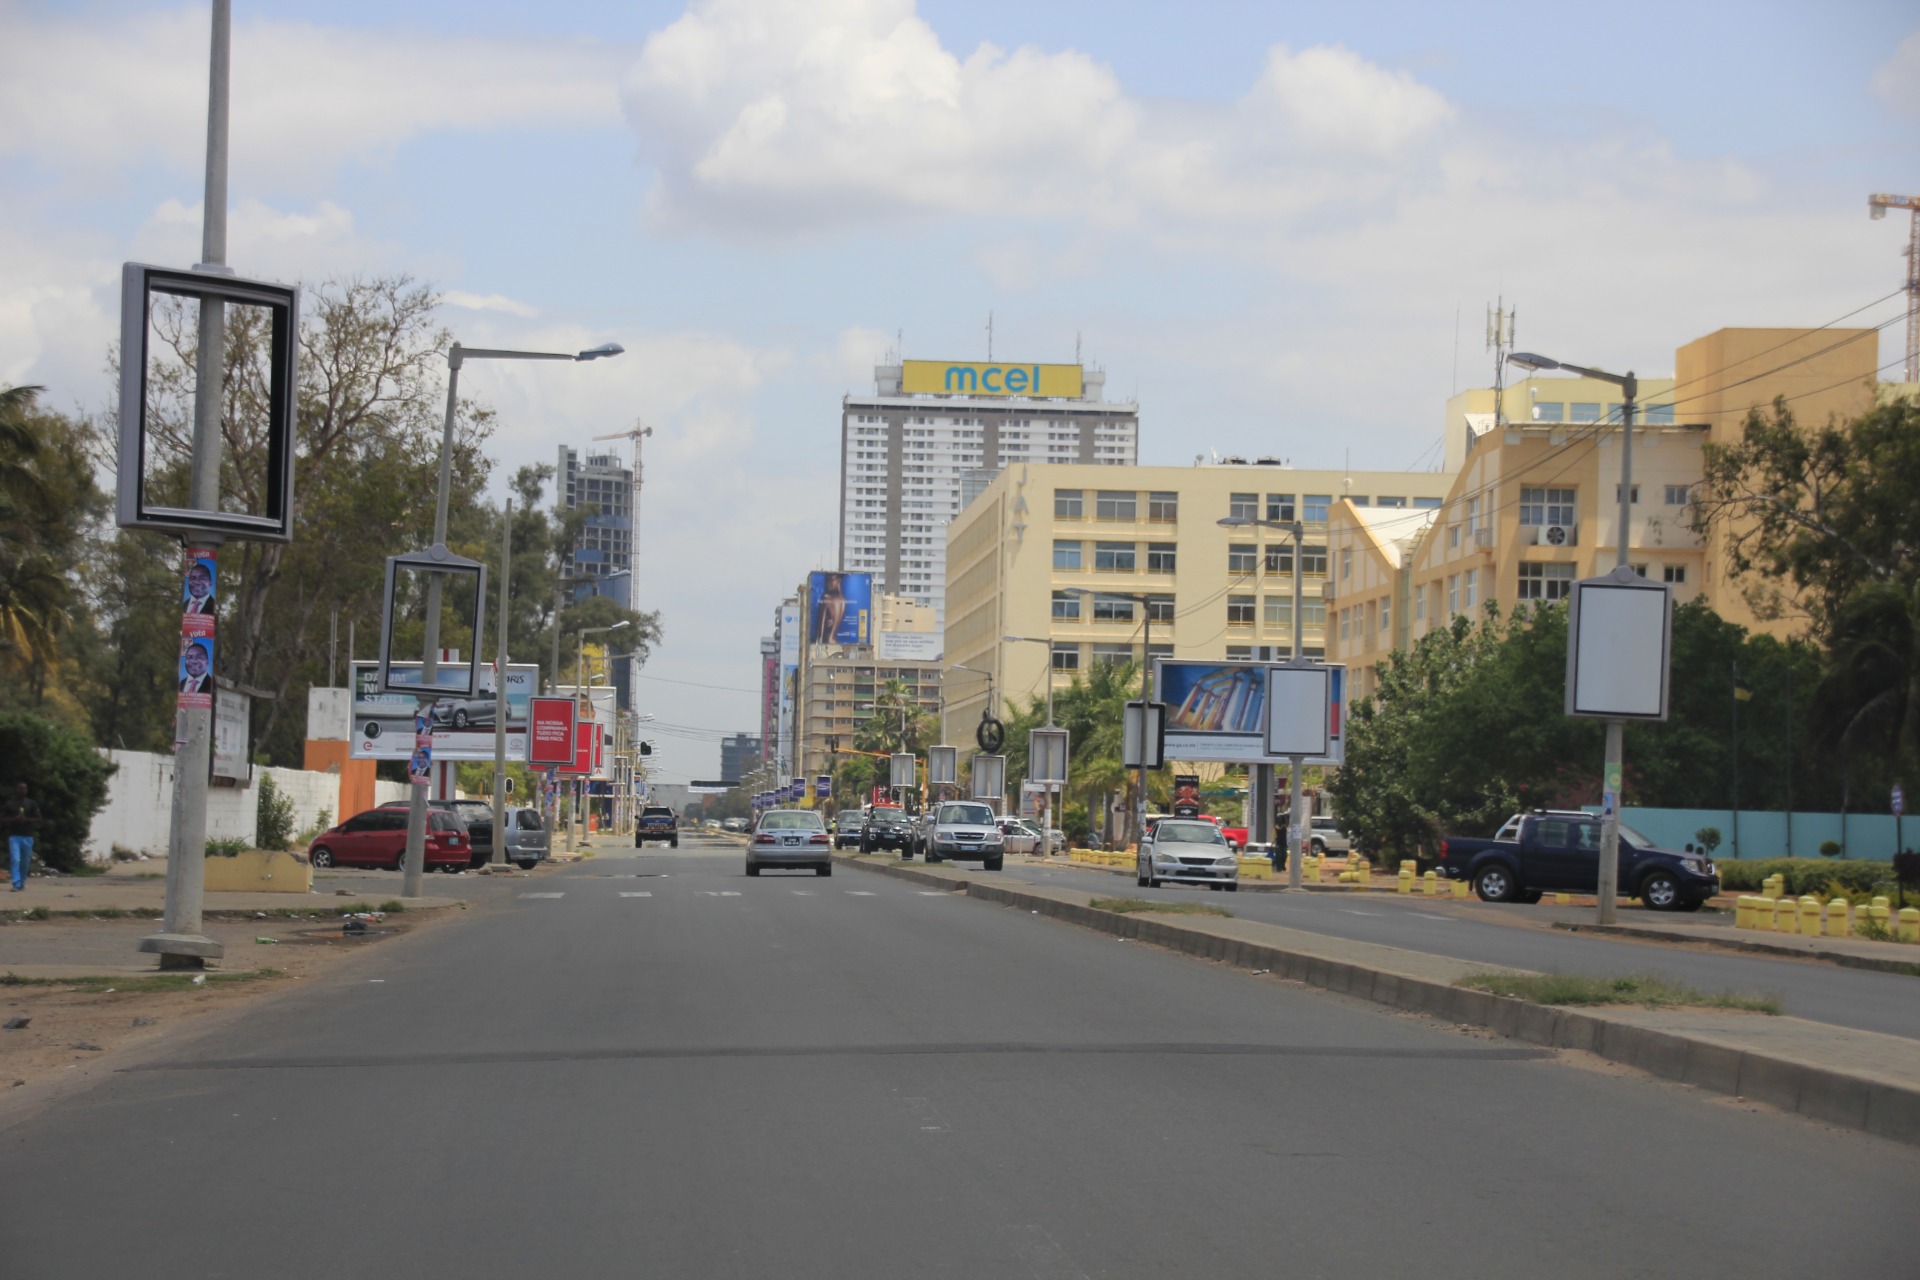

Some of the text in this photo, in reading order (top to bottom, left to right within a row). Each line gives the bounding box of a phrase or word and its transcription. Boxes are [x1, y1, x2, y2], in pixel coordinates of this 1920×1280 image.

[945, 365, 1040, 393] mcel
[190, 630, 206, 638] Vota
[364, 694, 403, 704] START
